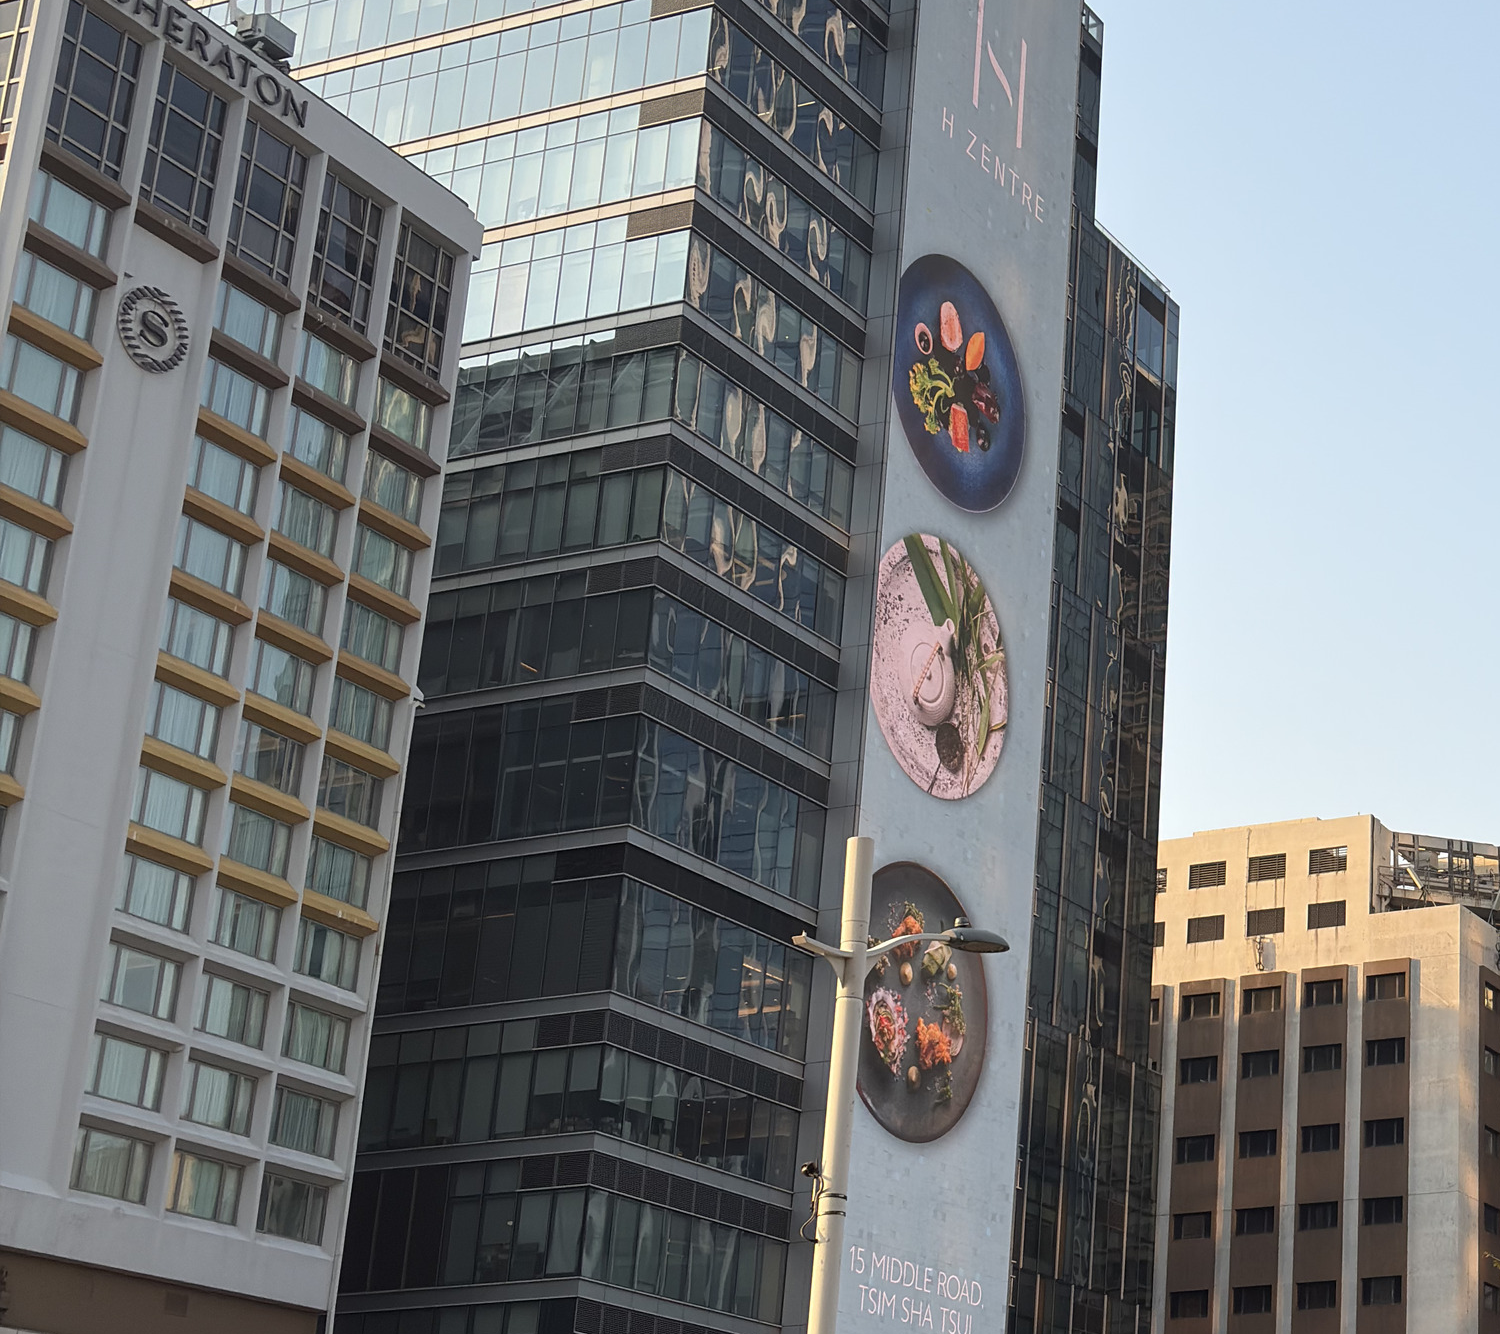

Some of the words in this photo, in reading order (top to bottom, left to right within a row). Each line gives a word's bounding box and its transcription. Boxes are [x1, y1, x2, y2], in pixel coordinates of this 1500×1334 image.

[942, 107, 954, 139] H
[966, 129, 1045, 223] ZENTRE
[849, 1245, 865, 1274] 15
[870, 1252, 934, 1293] MIDDLE
[937, 1271, 985, 1309] ROAD,
[859, 1284, 896, 1320] TSIM
[901, 1296, 934, 1330] SHA
